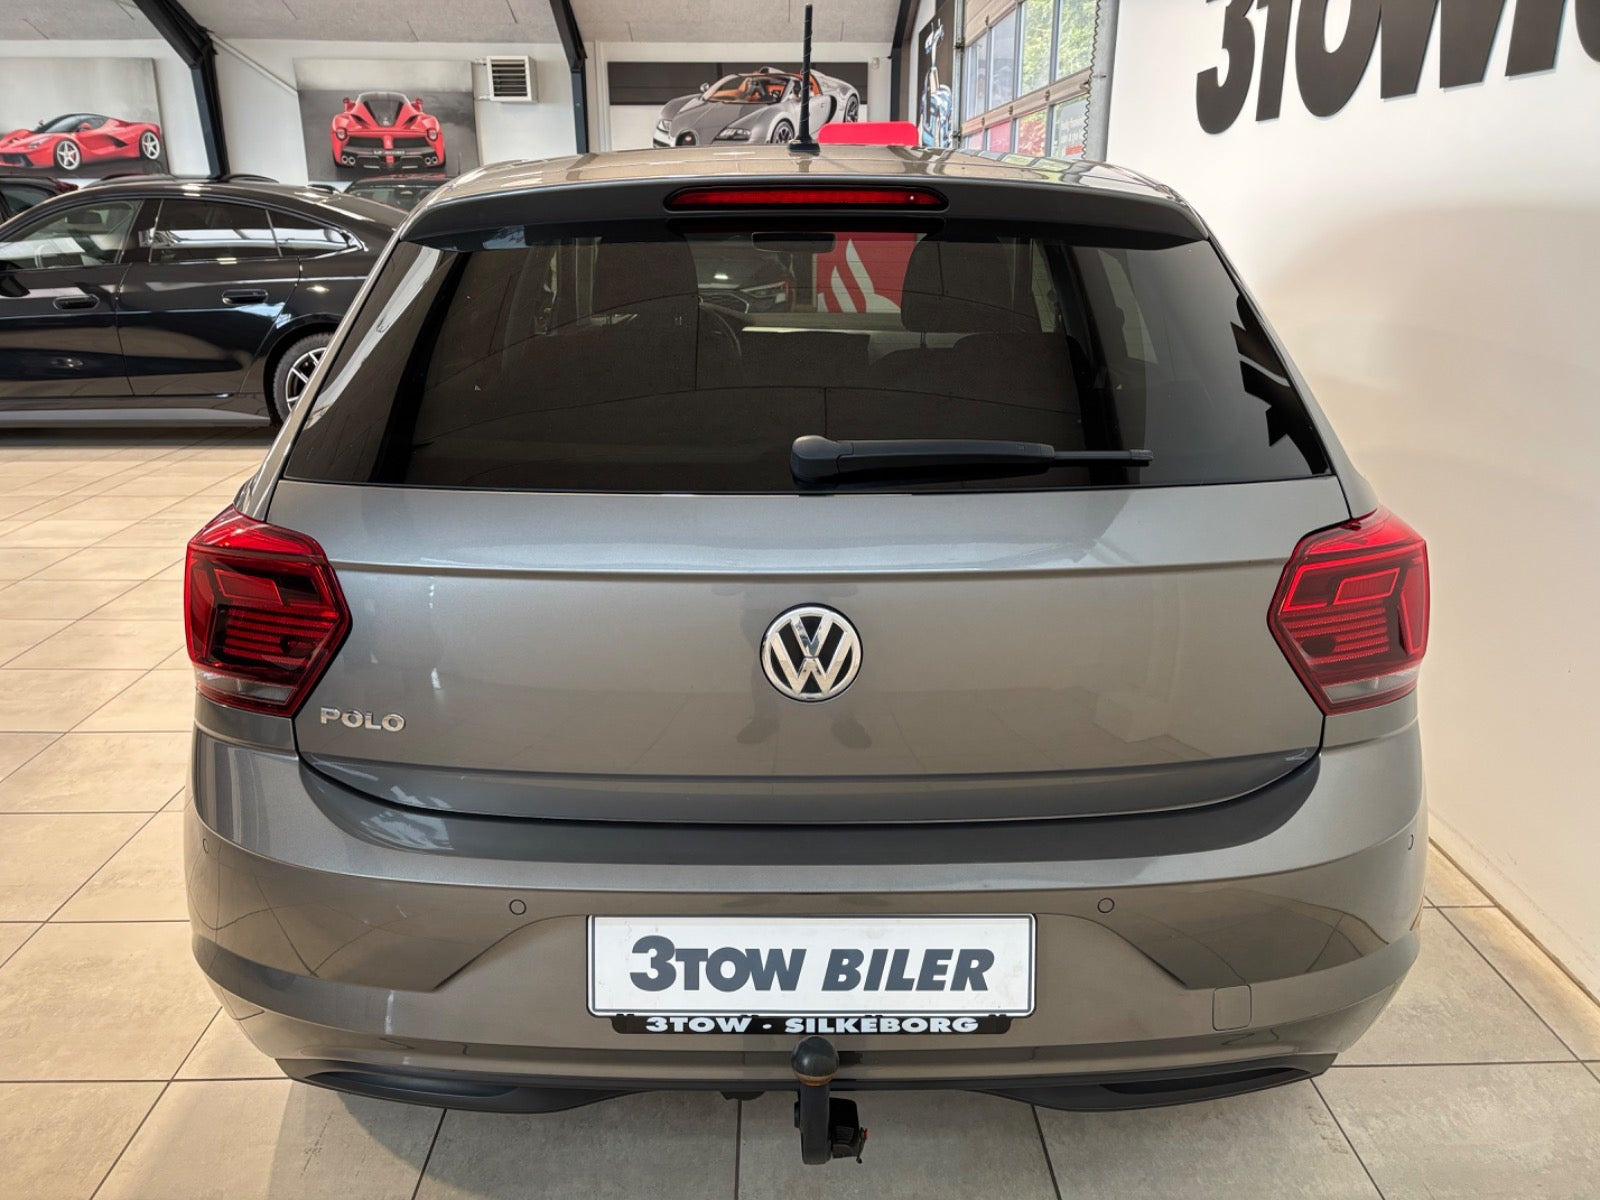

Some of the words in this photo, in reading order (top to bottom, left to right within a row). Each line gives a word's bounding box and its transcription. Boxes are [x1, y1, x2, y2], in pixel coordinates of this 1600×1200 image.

[320, 706, 405, 732] POLO
[630, 935, 806, 991] 3TOW
[821, 948, 995, 991] BILER
[646, 1017, 752, 1033] 3TOW
[784, 1017, 979, 1033] SILKEBORG
